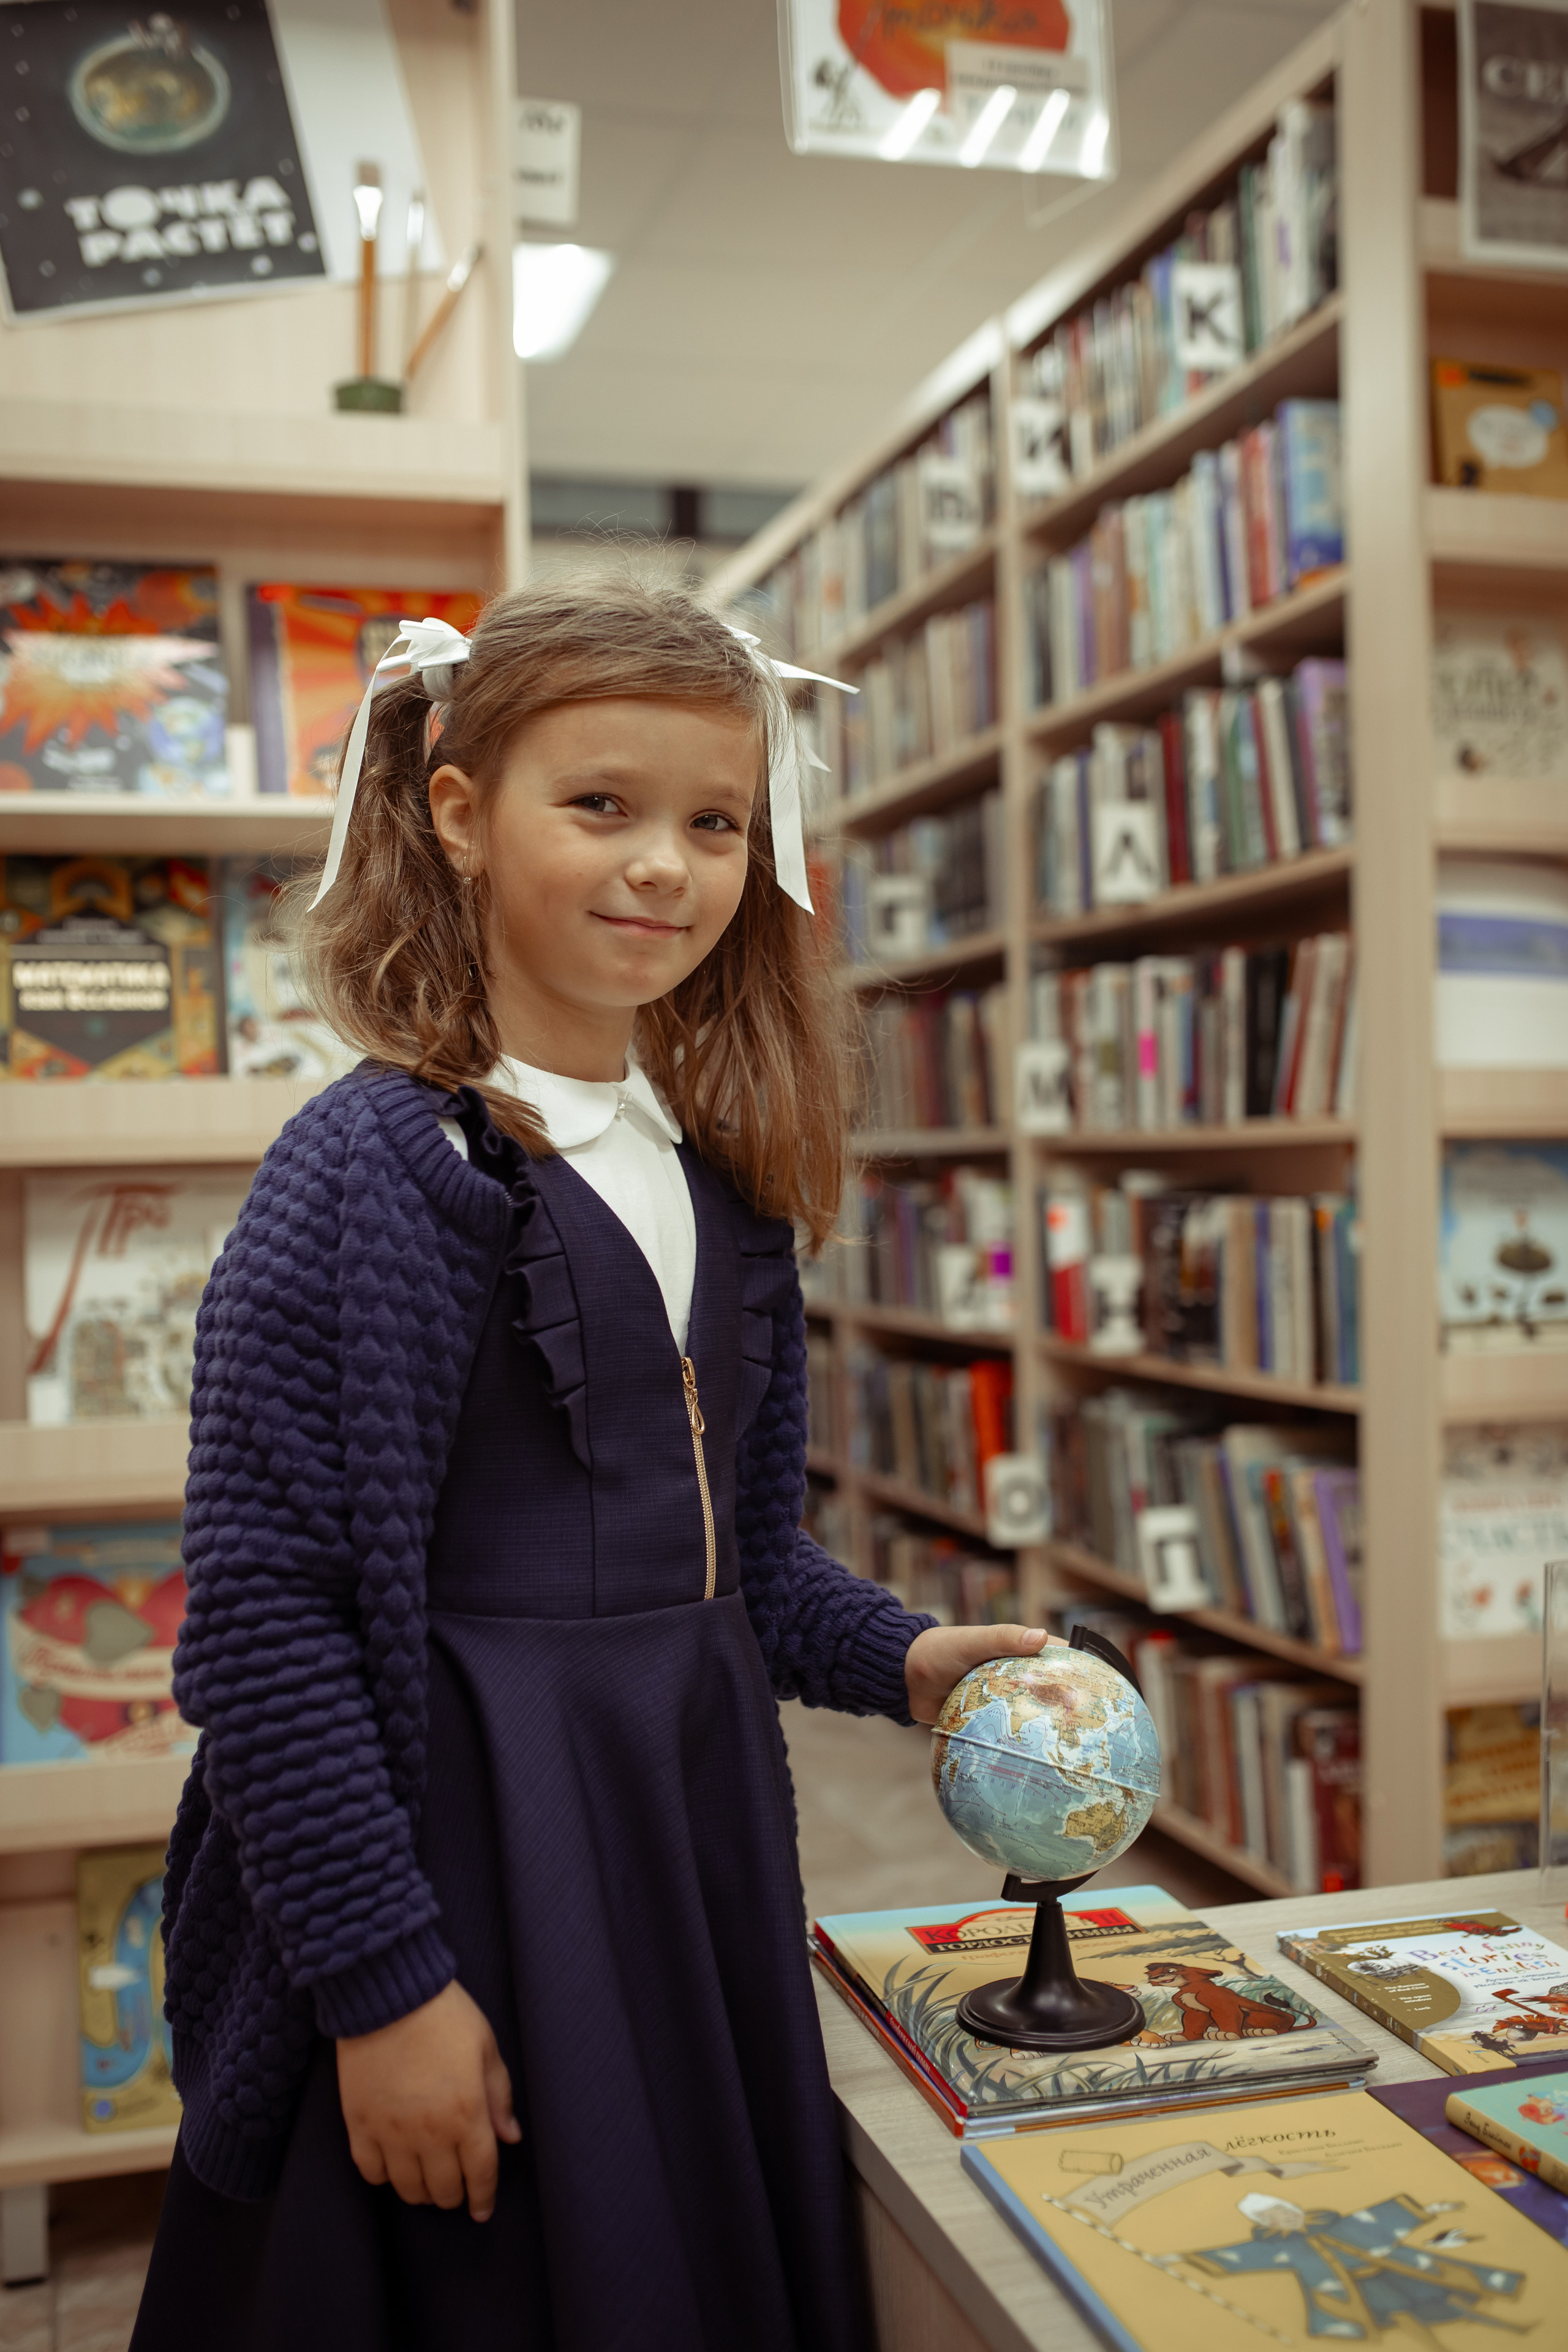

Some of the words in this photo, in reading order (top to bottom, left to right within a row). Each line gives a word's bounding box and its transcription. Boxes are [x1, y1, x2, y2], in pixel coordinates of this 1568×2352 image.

[63, 175, 292, 234] ТОЧКА
[936, 1936, 1032, 1952] ГОРДОСТ
[1066, 1925, 1135, 1939] ИМБЫ
[1404, 1945, 1468, 1962] Best
[1481, 1942, 1545, 1953] funny
[1439, 1951, 1548, 1971] stories
[1478, 1960, 1561, 1975] English
[1083, 2147, 1212, 2209] Утраченная
[1224, 2128, 1336, 2152] лёгкость
